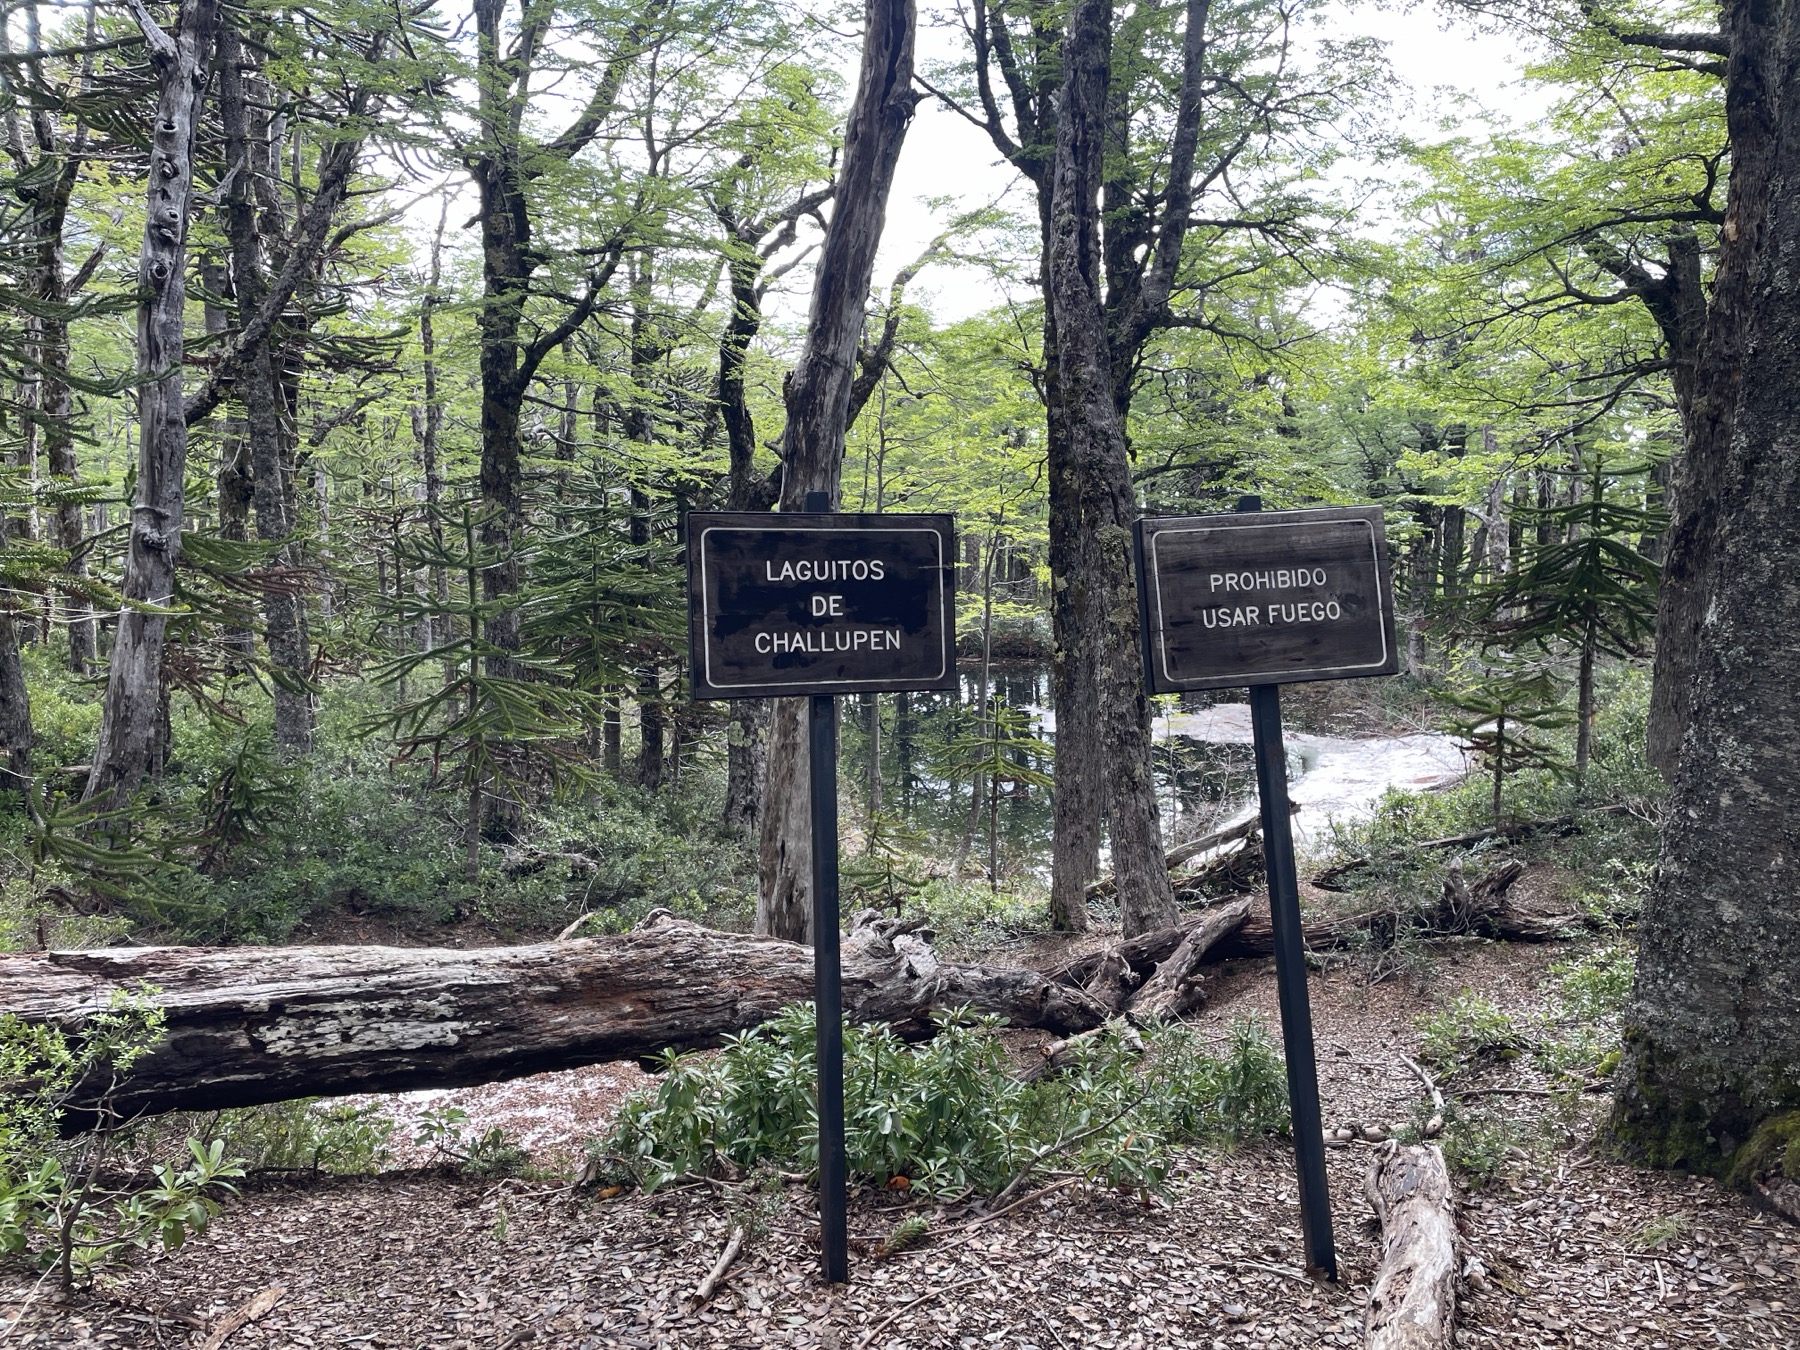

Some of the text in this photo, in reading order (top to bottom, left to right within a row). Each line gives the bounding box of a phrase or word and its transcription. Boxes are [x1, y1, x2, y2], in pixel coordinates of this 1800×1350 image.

[766, 560, 885, 581] LAGUITOS
[1210, 568, 1327, 592] PROHIBIDO
[812, 595, 843, 617] DE
[1202, 601, 1340, 629] USAR FUEGO
[754, 630, 901, 654] CHALLUPEN
